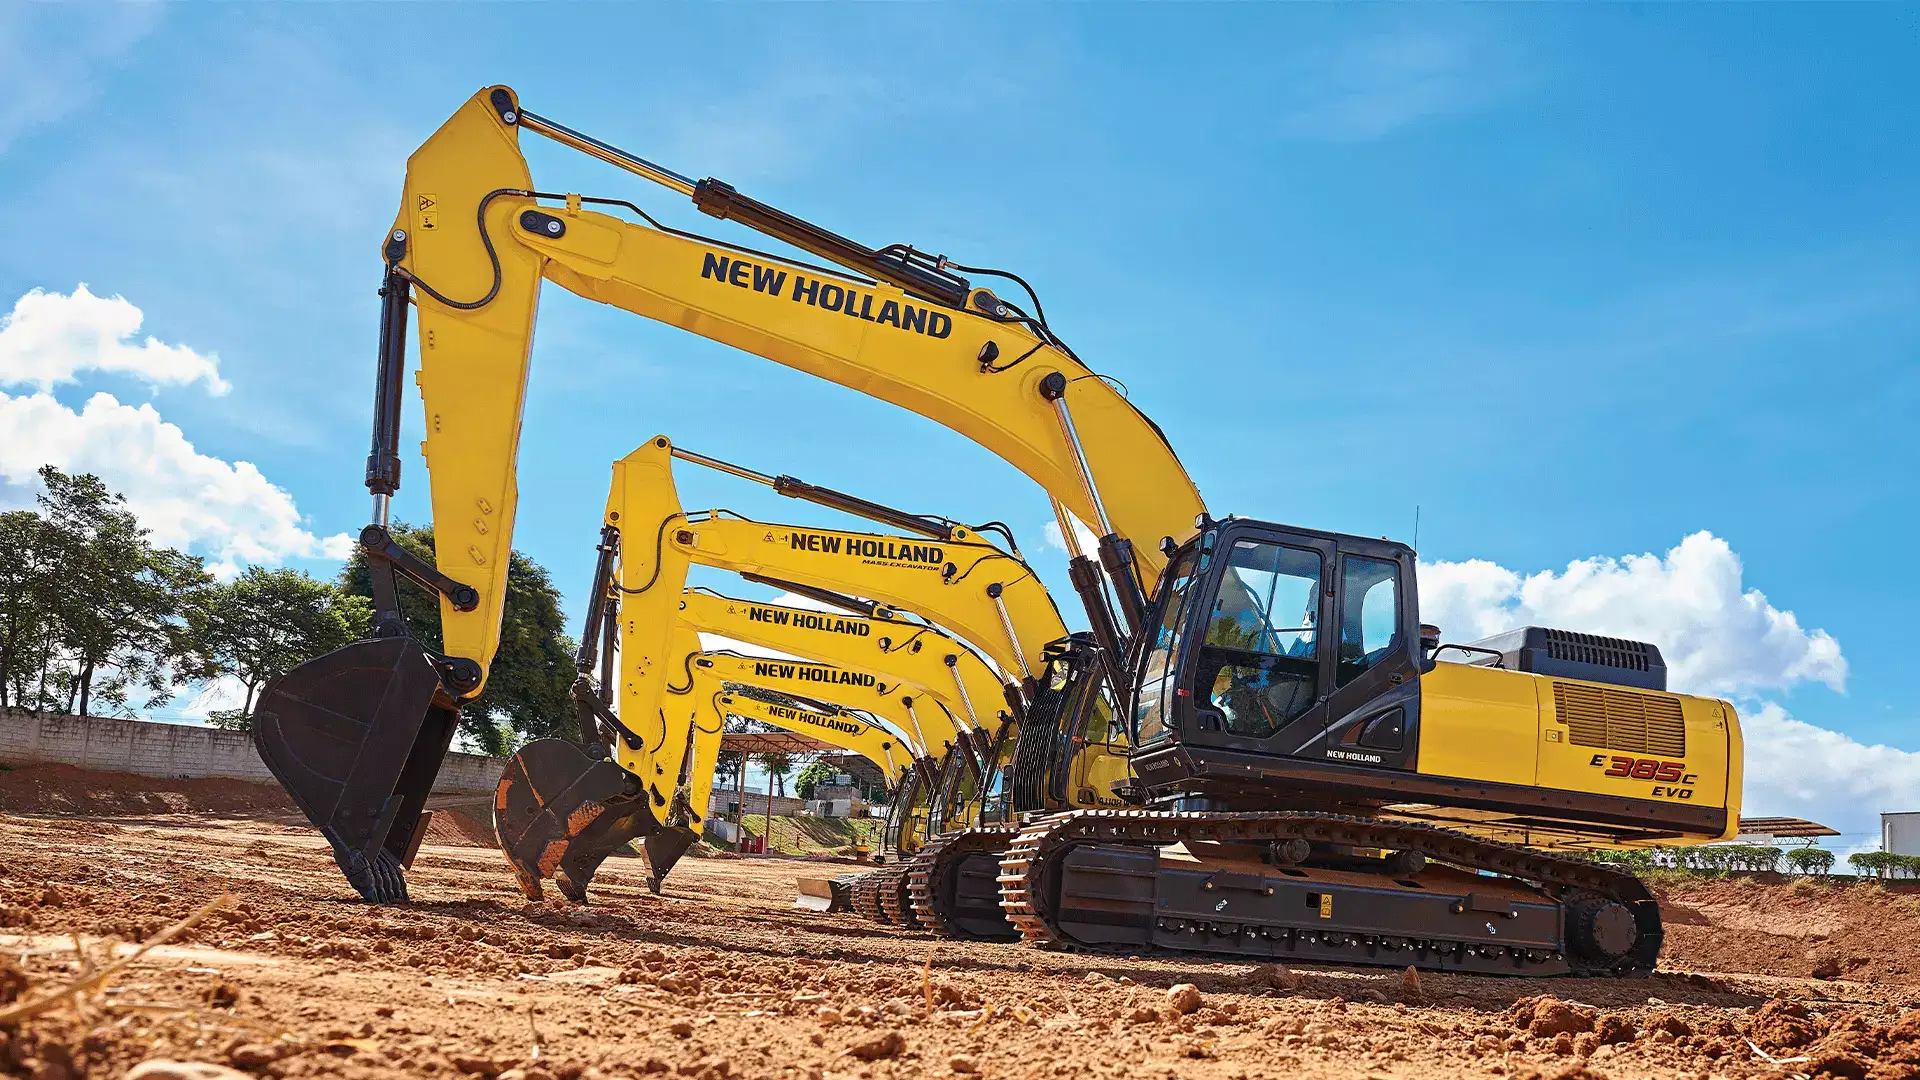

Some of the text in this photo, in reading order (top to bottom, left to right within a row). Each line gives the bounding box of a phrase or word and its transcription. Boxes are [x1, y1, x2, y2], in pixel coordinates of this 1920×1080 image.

[701, 252, 952, 340] NEW HOLLAND
[791, 532, 943, 564] NEW HOLLAND
[862, 559, 940, 572] MASS EXCAVATOR
[749, 607, 870, 637] NEW HOLLAND
[755, 662, 876, 687] NEW HOLLAND
[768, 705, 854, 733] NEW HOLLAND
[1326, 749, 1381, 763] NEW HOLLAND
[1651, 786, 1694, 799] EVO
